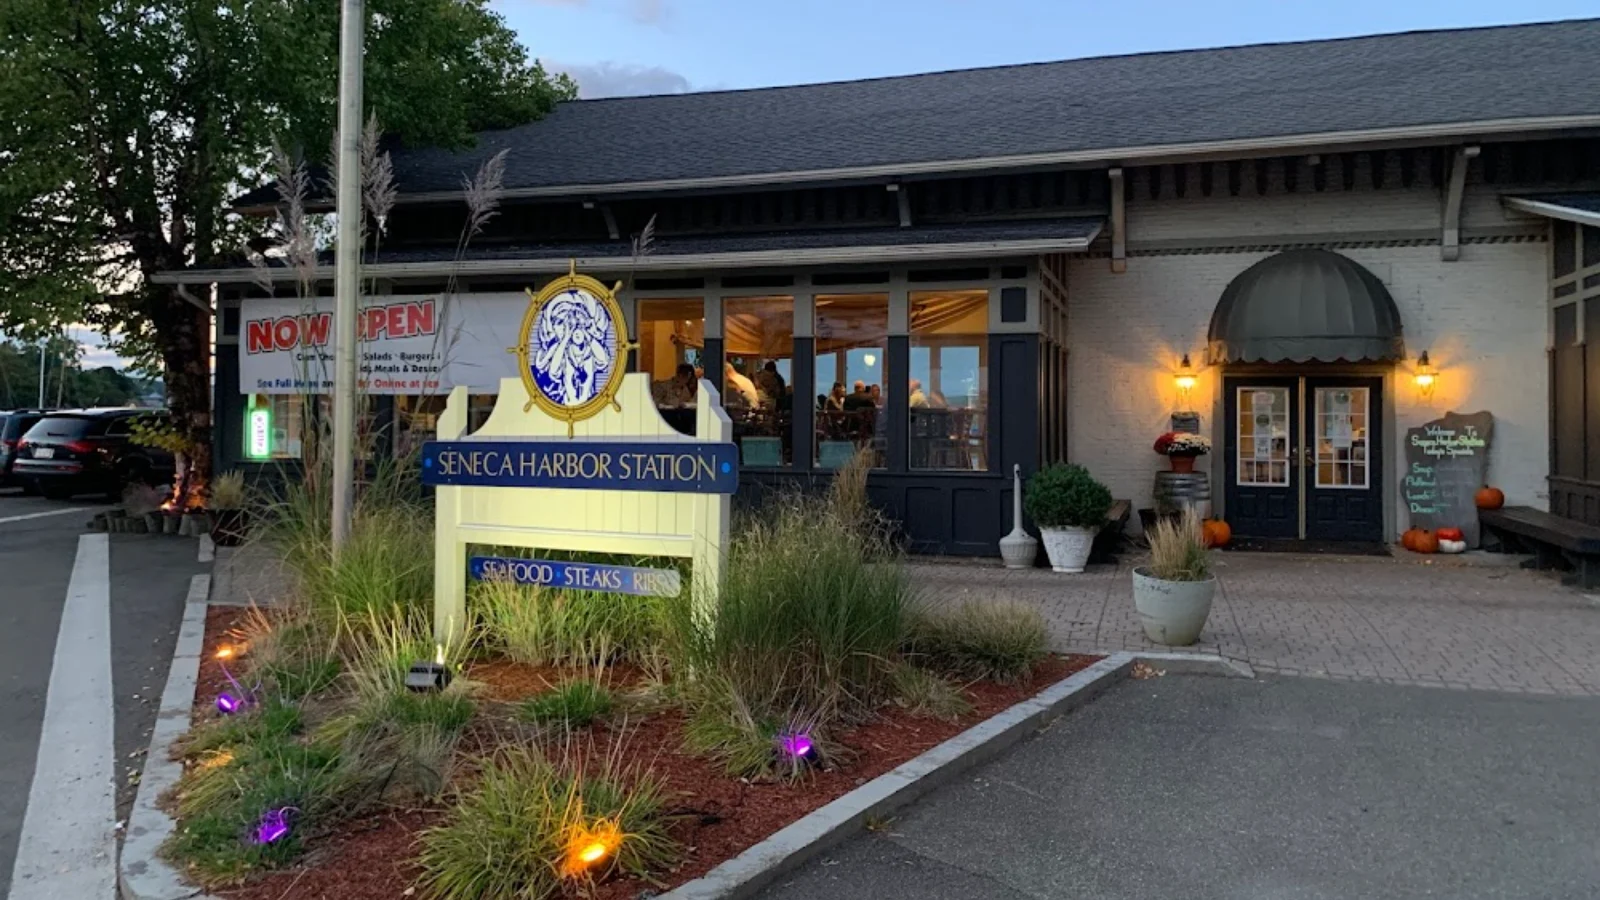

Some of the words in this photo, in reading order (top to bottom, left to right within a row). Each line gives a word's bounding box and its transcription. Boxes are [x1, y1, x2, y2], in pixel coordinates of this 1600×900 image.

[248, 312, 333, 354] NOW
[363, 352, 392, 361] Salads
[374, 364, 400, 373] Meals
[257, 378, 273, 388] See
[275, 378, 292, 388] Full
[409, 379, 420, 388] at
[437, 451, 514, 476] SENECA
[519, 452, 612, 479] HARBOR
[618, 454, 717, 481] STATION
[482, 560, 553, 583] SEAFOOD
[564, 567, 622, 589] STEAKS
